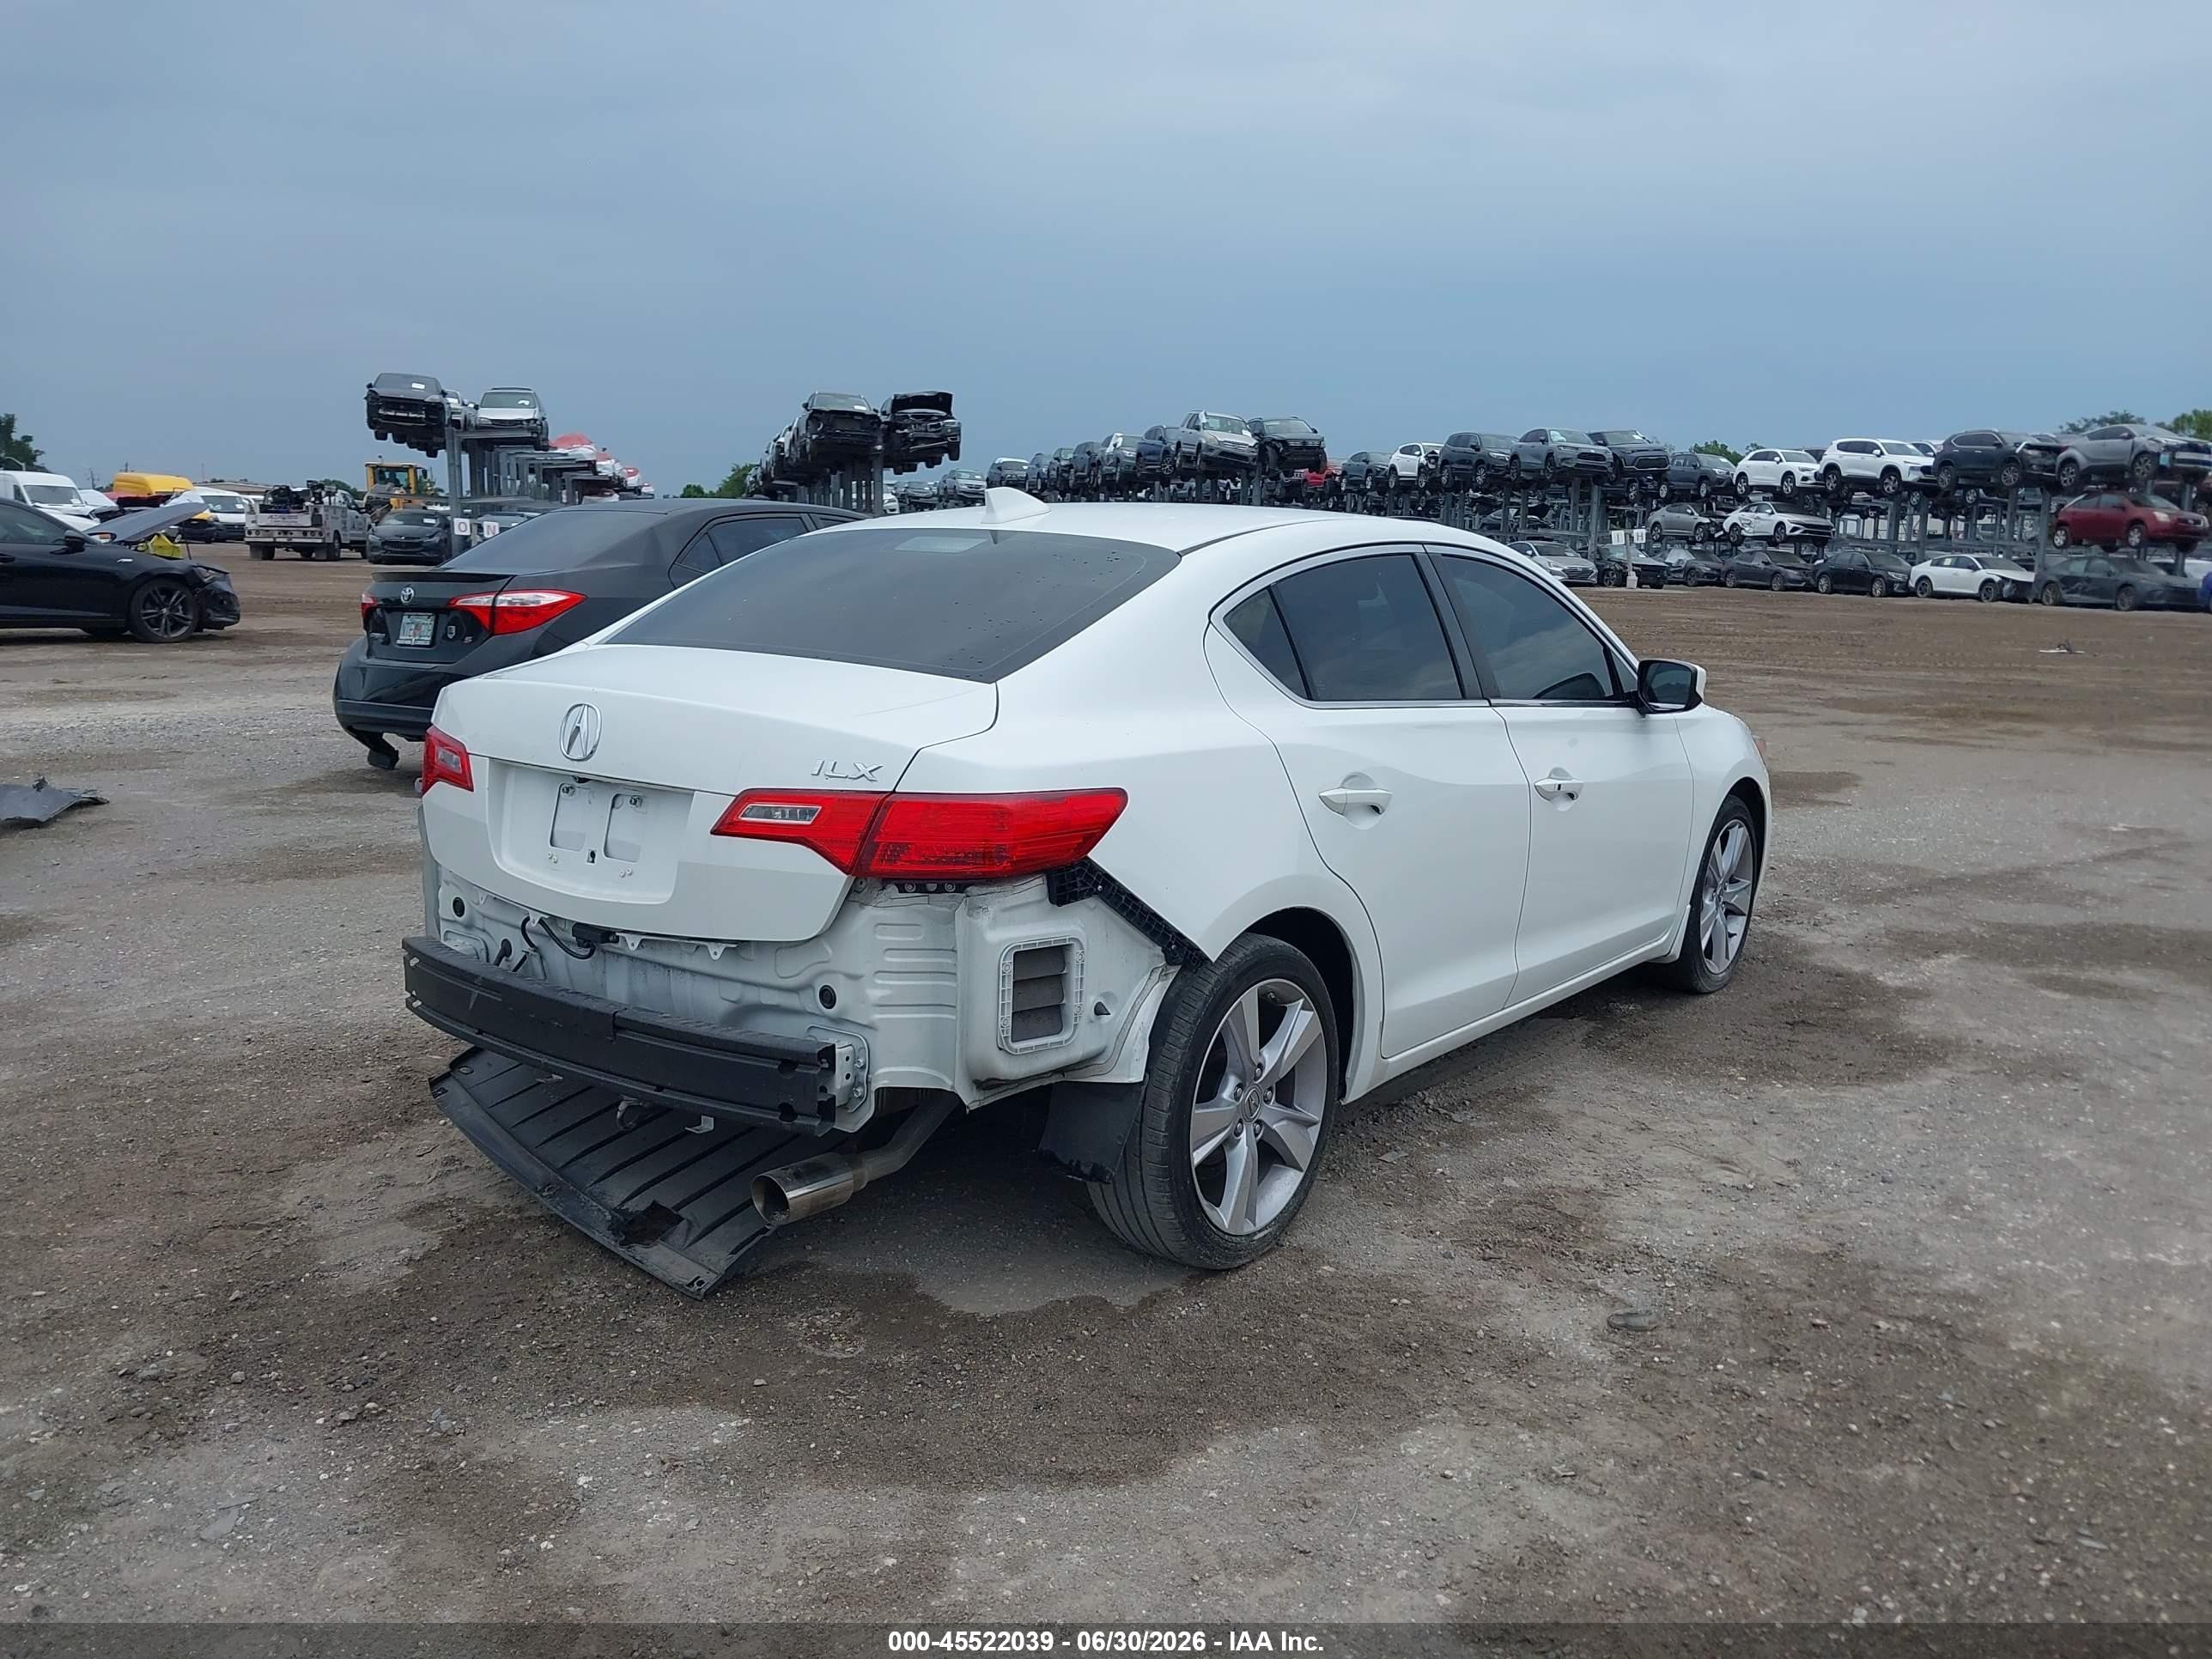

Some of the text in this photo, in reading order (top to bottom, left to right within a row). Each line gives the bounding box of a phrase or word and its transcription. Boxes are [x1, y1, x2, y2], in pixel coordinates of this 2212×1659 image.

[486, 525, 496, 536] N
[1637, 532, 1644, 542] H
[810, 758, 884, 782] ILX
